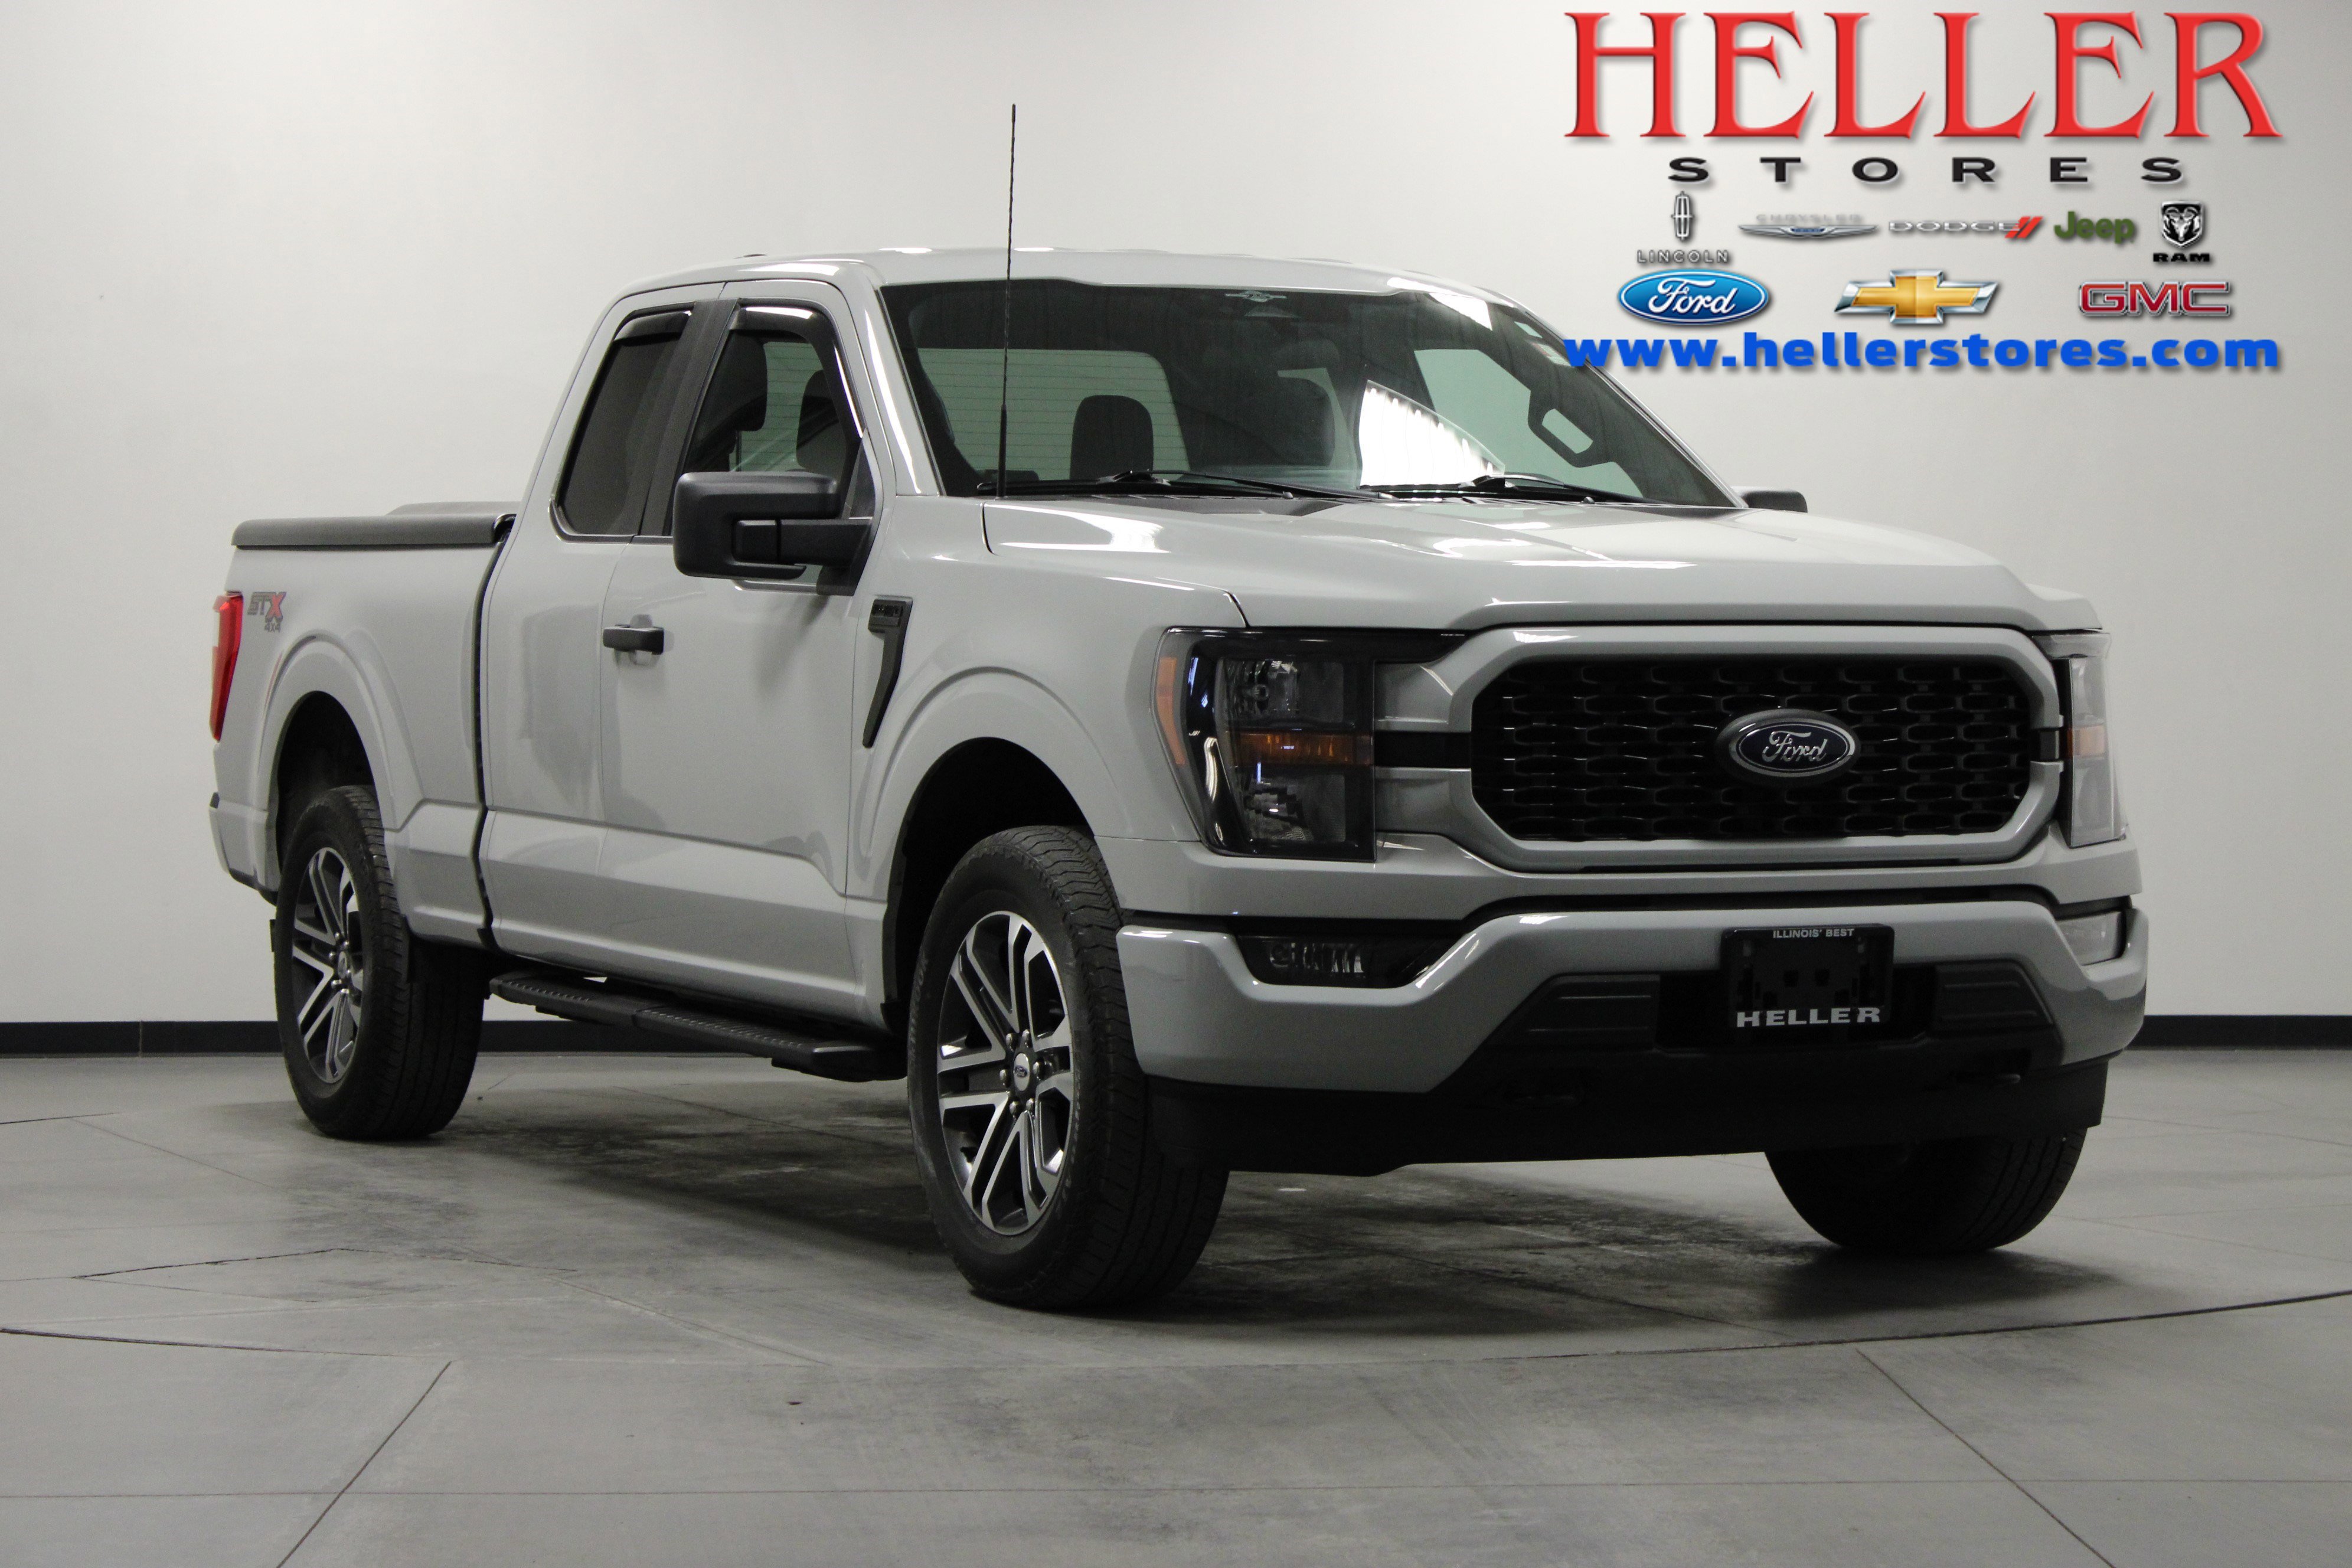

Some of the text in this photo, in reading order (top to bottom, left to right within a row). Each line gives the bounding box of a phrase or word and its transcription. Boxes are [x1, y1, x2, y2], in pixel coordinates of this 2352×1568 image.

[247, 592, 286, 622] STX
[1762, 730, 1828, 762] Ford
[1773, 928, 1854, 939] ILLINOIS' BEST
[1737, 1007, 1880, 1028] HELLER
